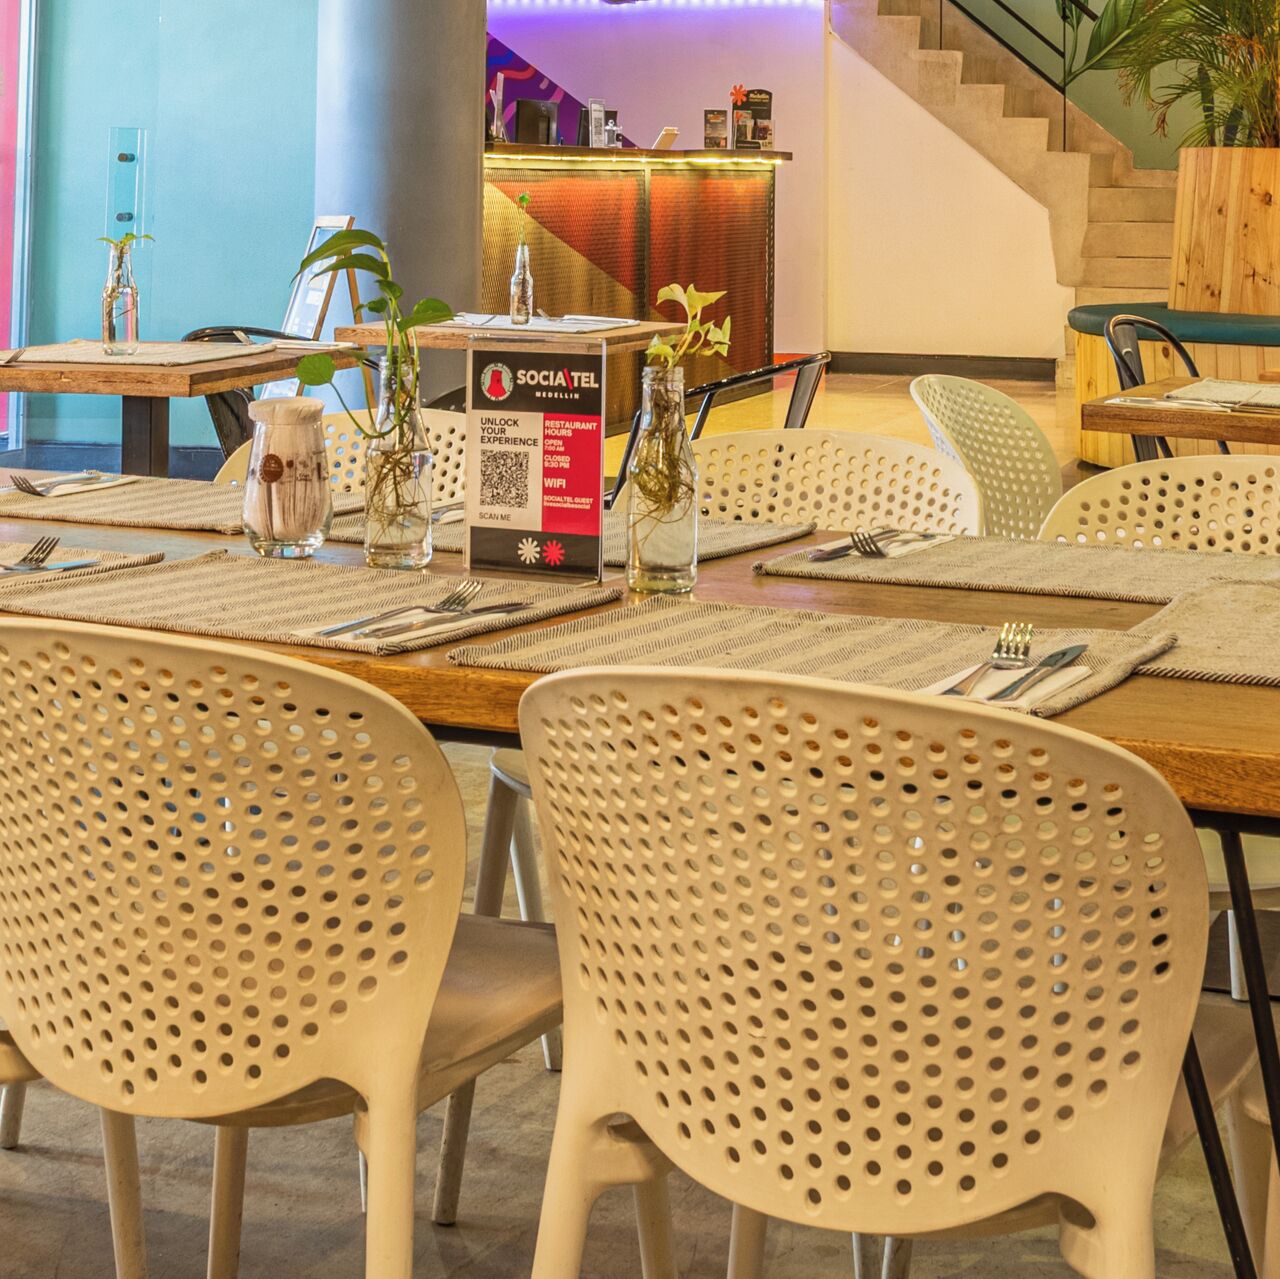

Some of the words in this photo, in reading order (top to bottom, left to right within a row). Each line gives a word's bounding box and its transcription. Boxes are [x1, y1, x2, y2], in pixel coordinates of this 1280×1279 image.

[535, 391, 580, 399] MEDELLIN
[480, 417, 520, 428] UNLOCK
[544, 420, 598, 431] RESTAURANT
[480, 426, 507, 436] YOUR
[544, 428, 573, 438] HOURS
[480, 435, 539, 447] EXPERIENCE
[543, 477, 567, 489] WIFI
[478, 512, 500, 521] SCAN
[500, 513, 511, 522] ME
